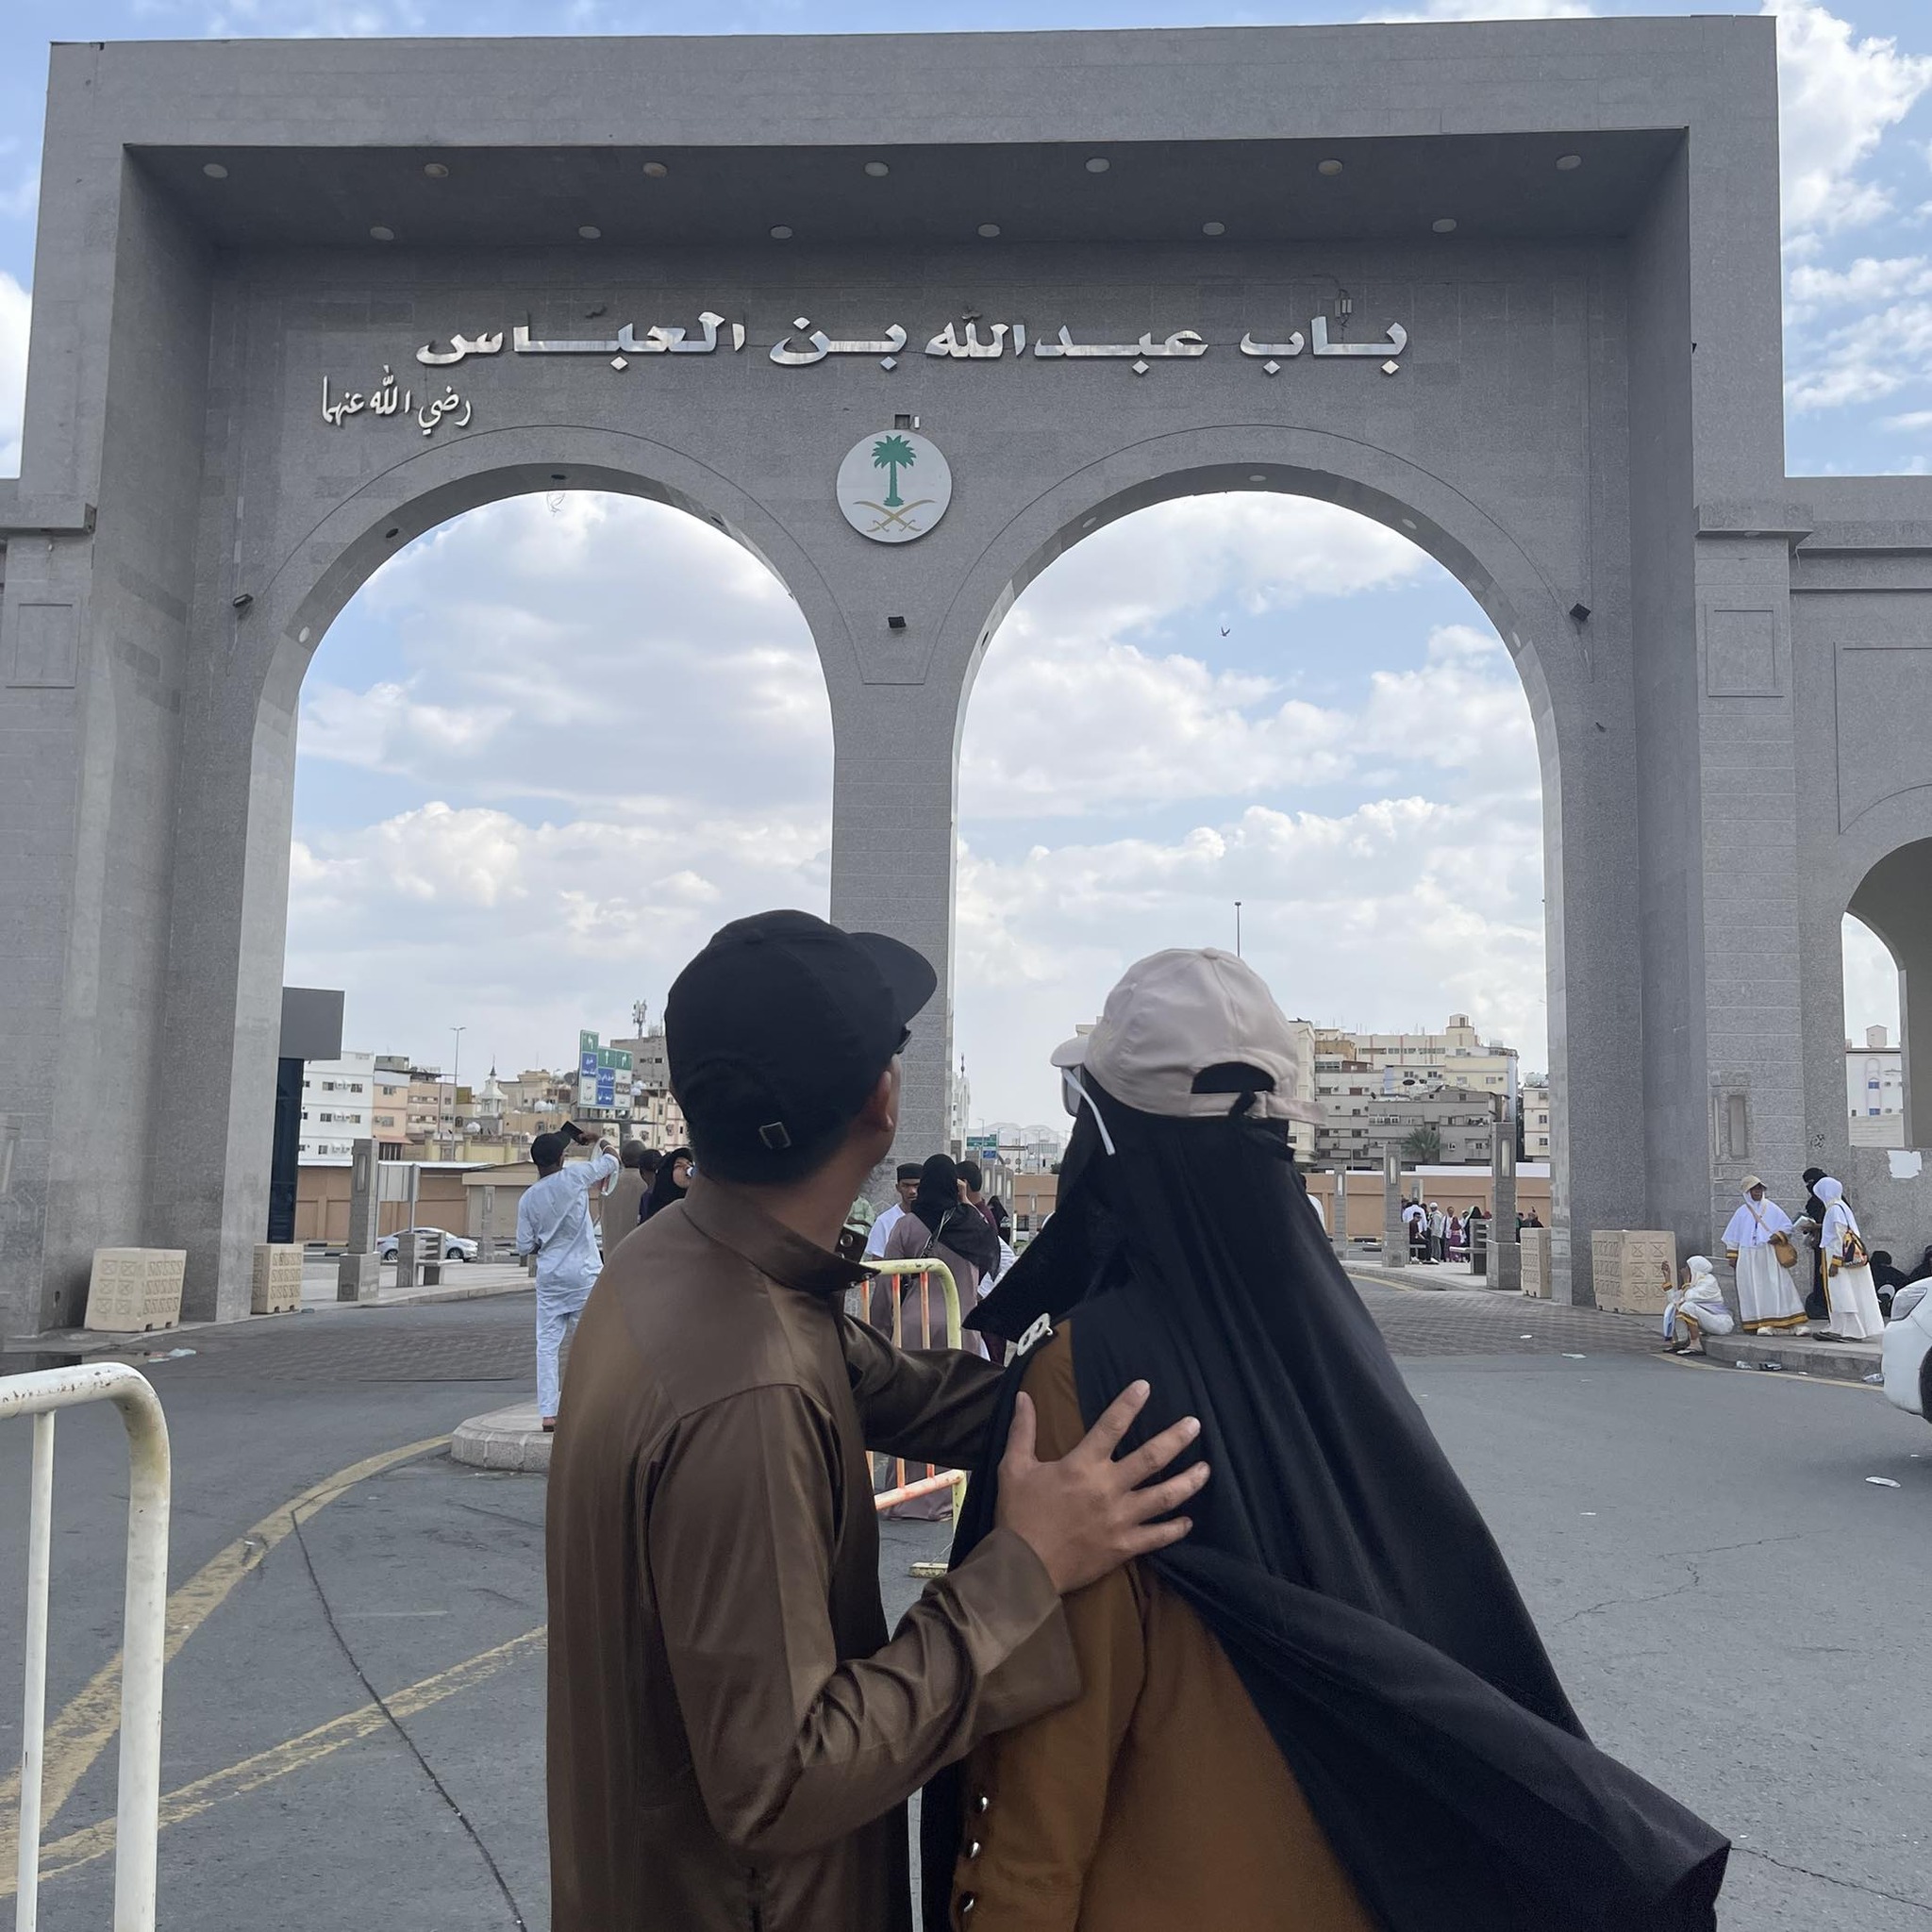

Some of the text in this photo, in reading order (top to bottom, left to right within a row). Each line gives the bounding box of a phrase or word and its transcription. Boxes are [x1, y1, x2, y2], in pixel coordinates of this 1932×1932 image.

[415, 310, 745, 371] العباس
[769, 316, 908, 371] بن
[1240, 315, 1408, 375] باب
[418, 385, 472, 436] رضي
